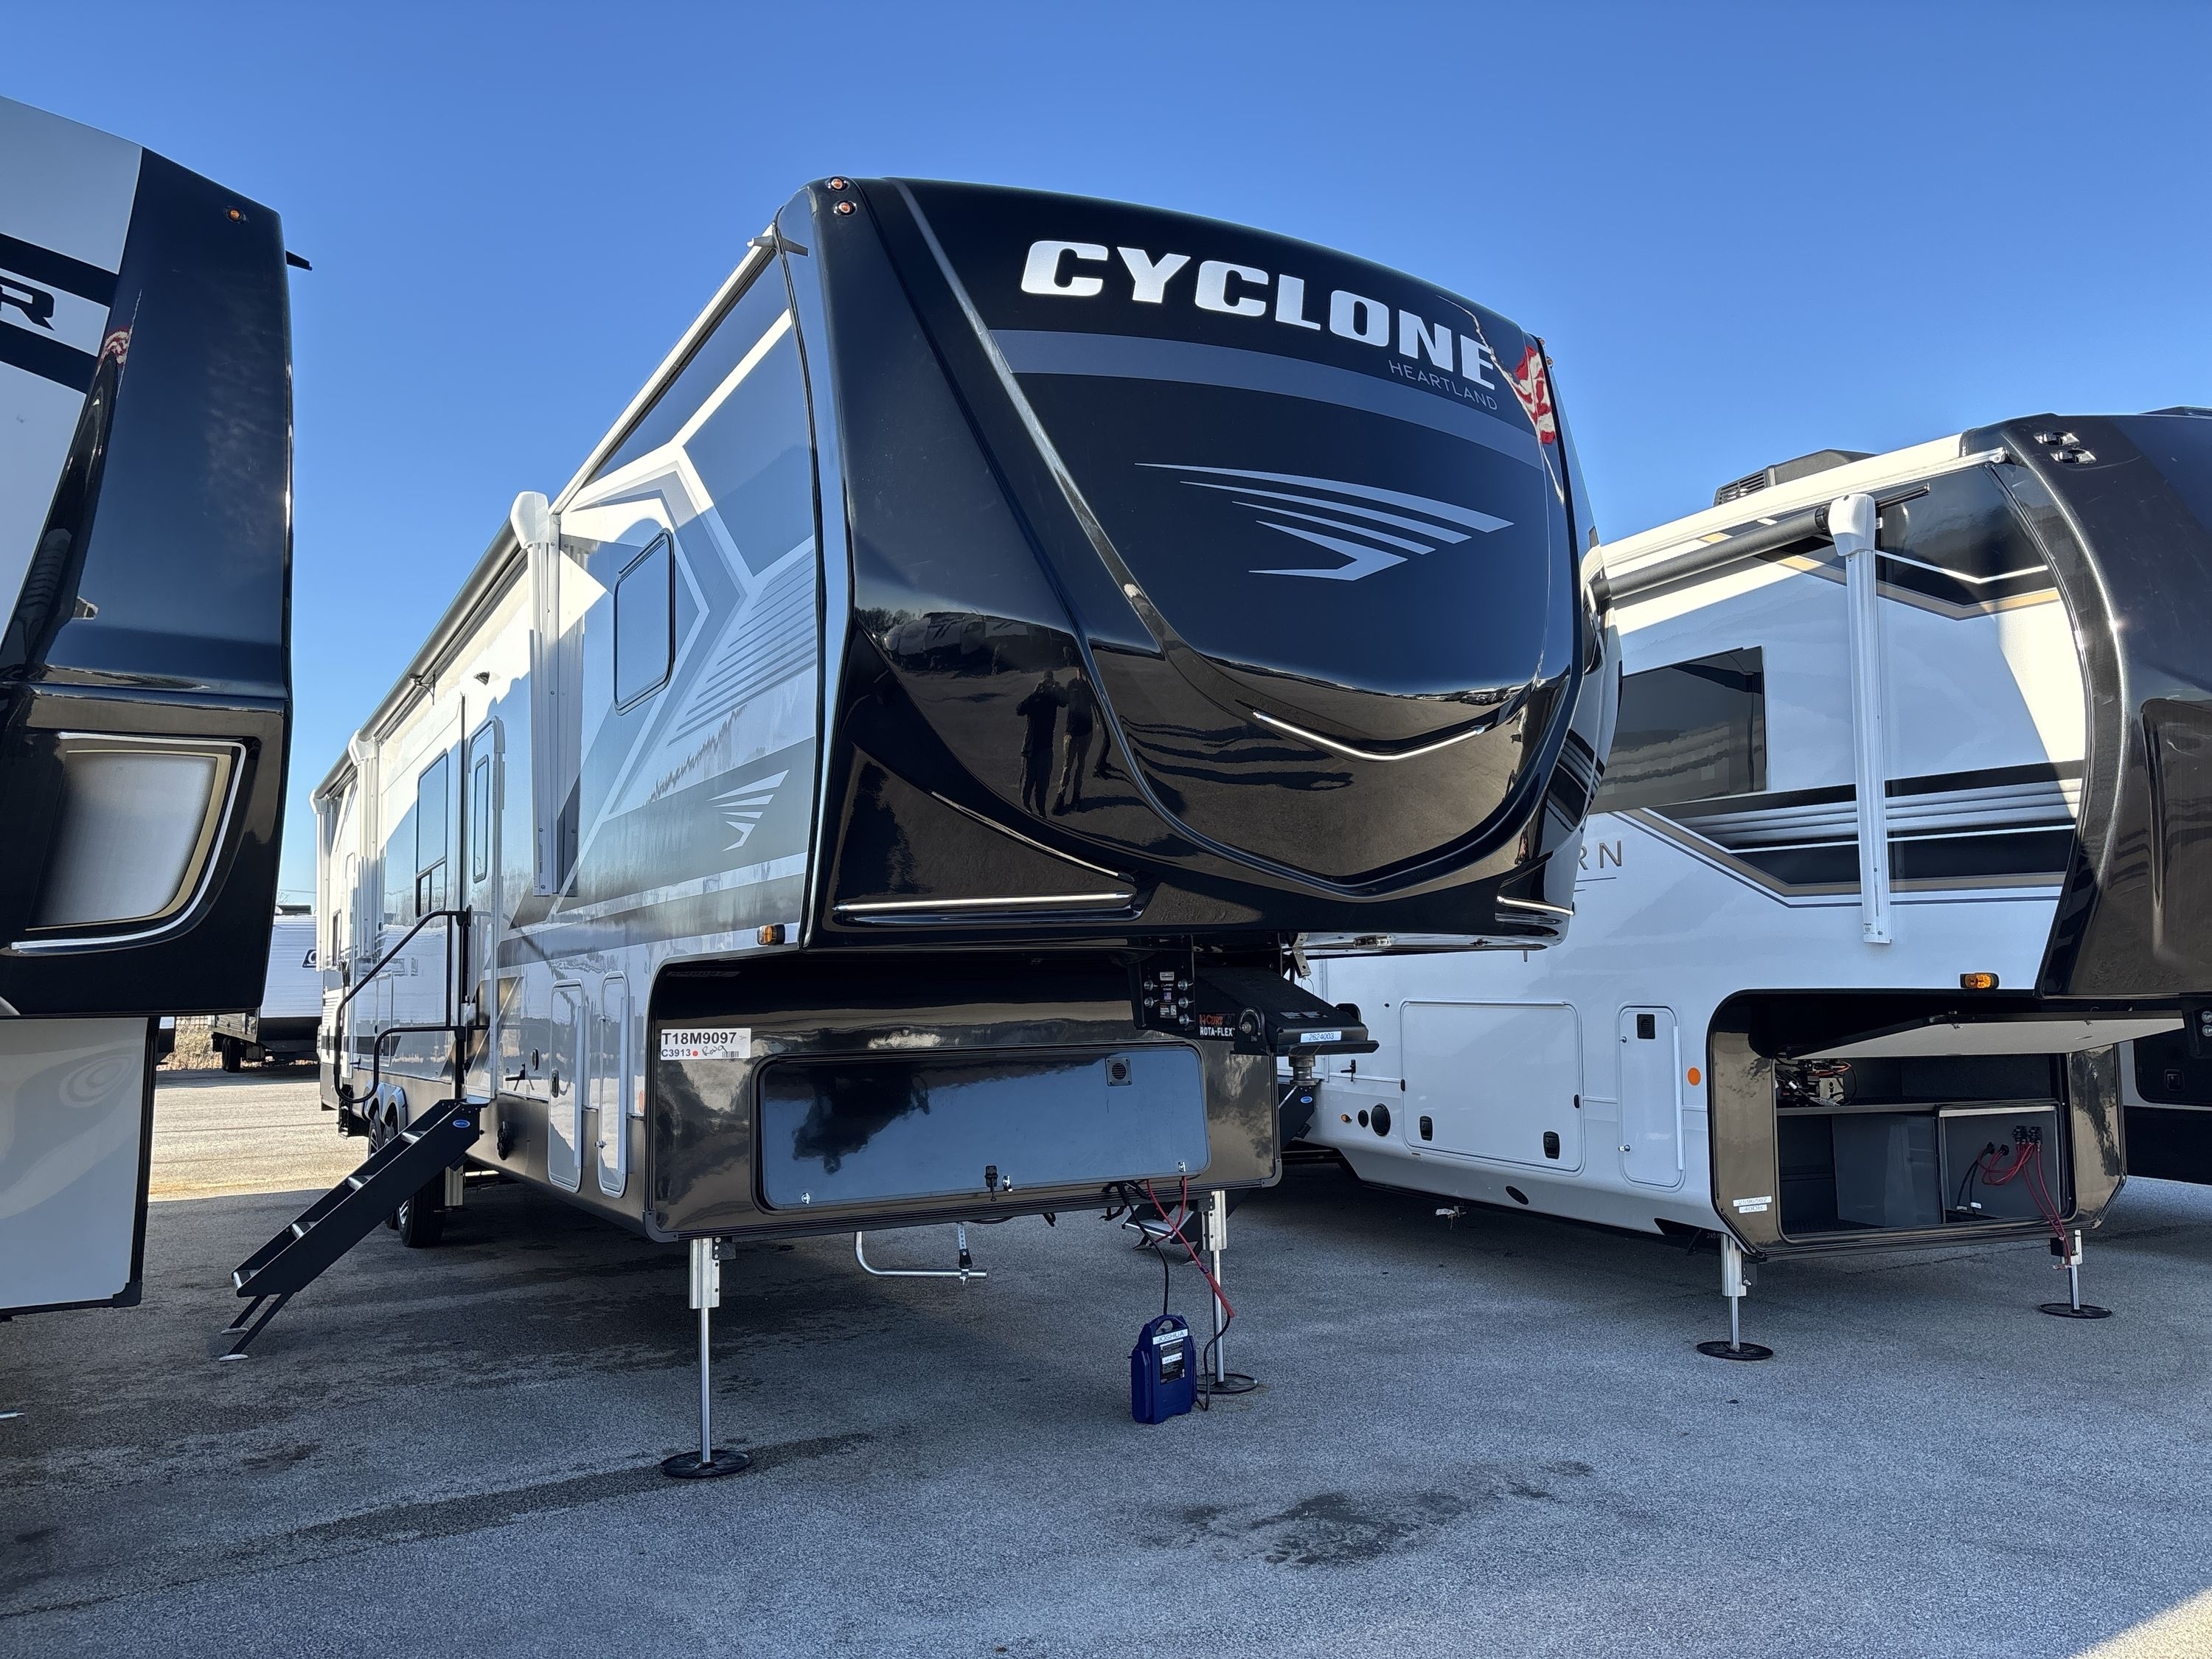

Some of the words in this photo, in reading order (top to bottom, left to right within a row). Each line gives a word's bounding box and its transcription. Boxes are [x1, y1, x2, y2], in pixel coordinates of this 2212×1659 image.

[1021, 240, 1495, 391] CYCLONE
[1388, 359, 1498, 410] HEARTLAND
[661, 1032, 737, 1045] T18M9097
[1308, 1032, 1335, 1041] 2624003
[661, 1049, 692, 1057] C3913
[1157, 1331, 1185, 1343] JOSHUA
